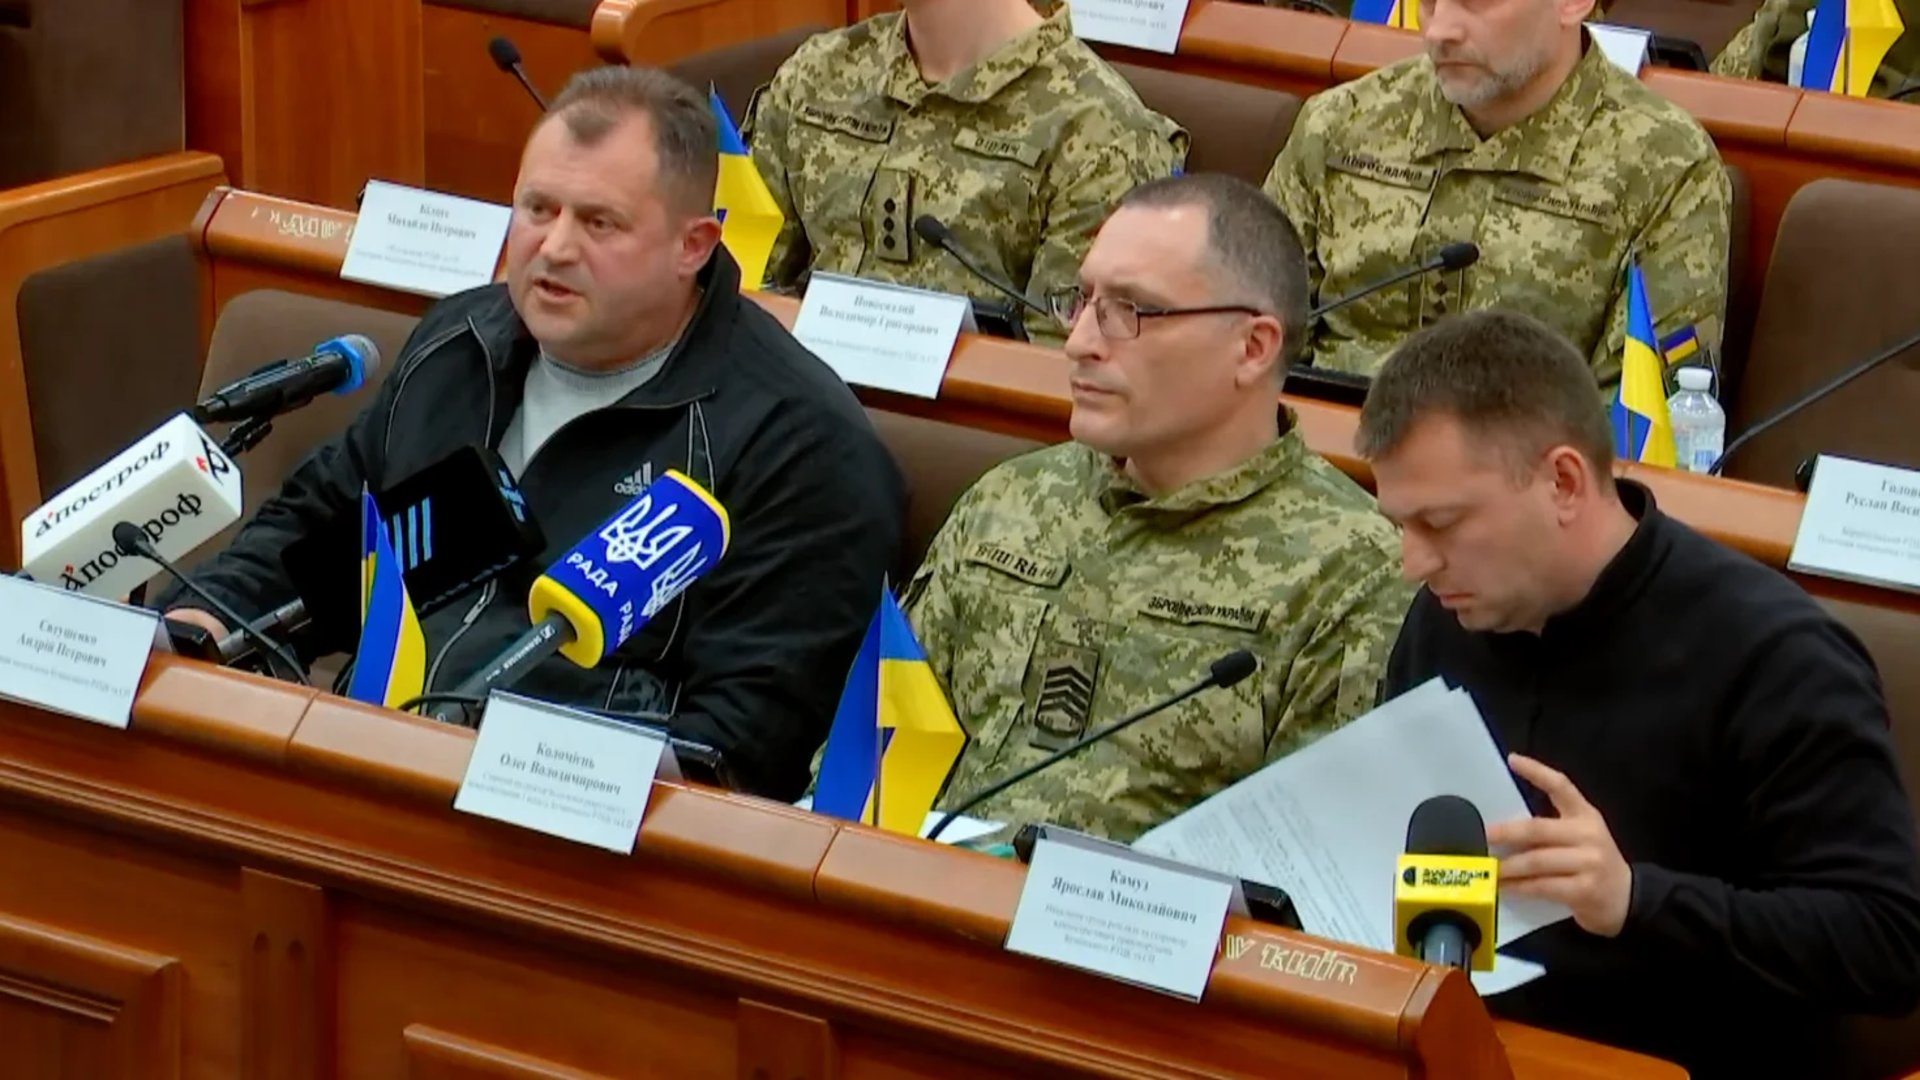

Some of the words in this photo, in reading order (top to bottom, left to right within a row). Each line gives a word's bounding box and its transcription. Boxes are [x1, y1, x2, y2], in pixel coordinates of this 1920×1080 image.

[1845, 491, 1888, 511] Руслан
[566, 552, 619, 598] РАДА
[17, 633, 54, 653] Андрій
[57, 642, 107, 667] Петрович
[499, 753, 527, 771] Олег
[530, 762, 621, 795] Володимирович
[1051, 876, 1104, 902] Ярослав
[1107, 891, 1197, 924] Миколайович
